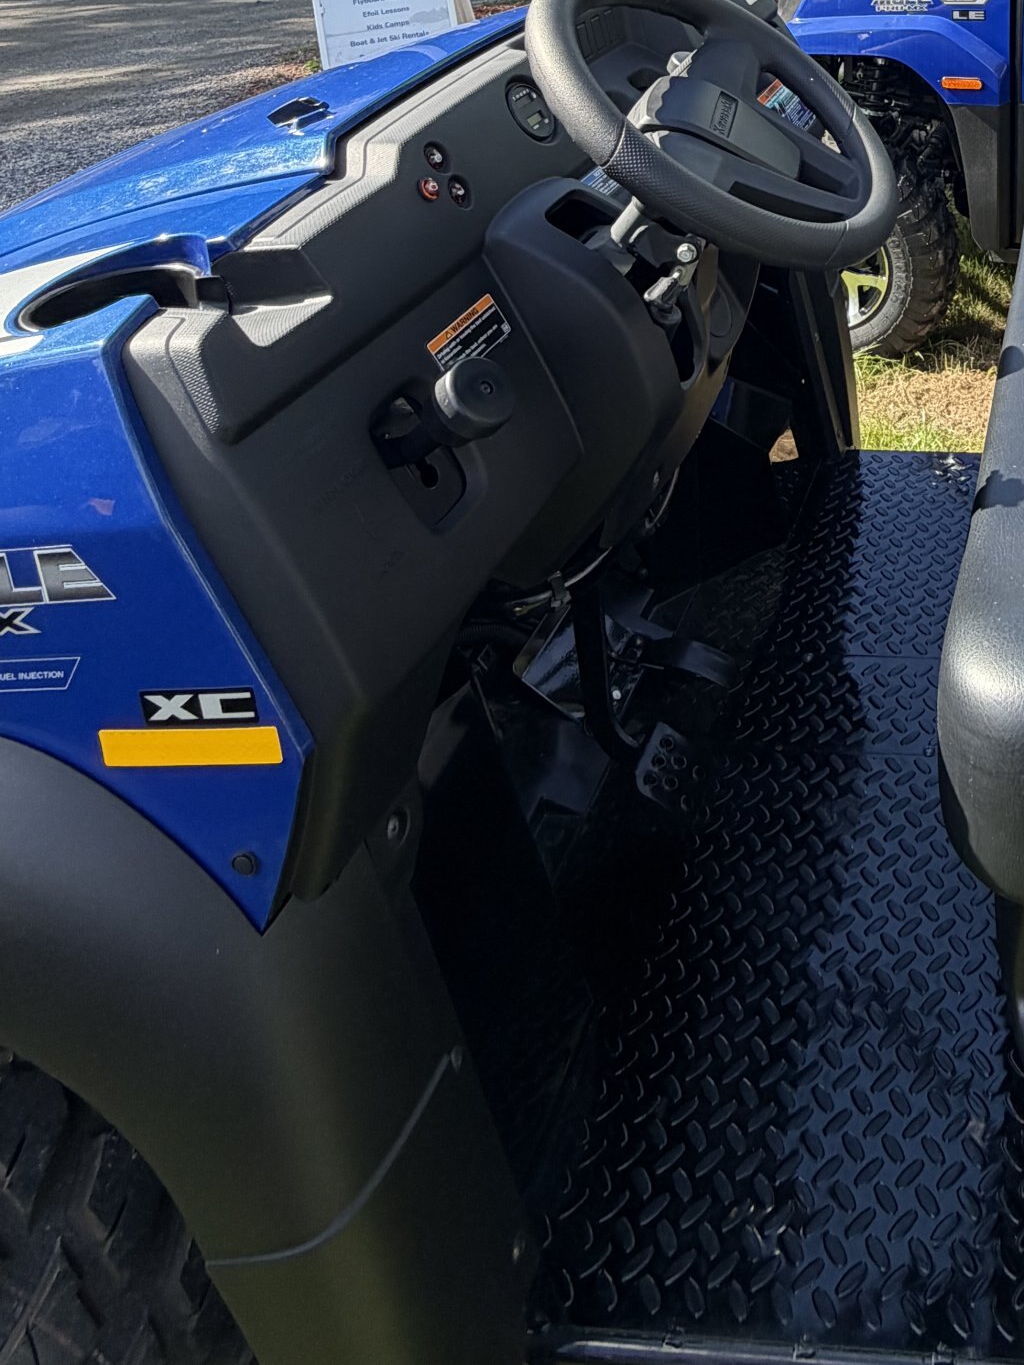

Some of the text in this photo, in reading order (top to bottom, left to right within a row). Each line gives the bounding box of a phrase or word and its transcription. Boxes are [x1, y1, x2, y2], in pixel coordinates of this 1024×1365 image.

[362, 5, 410, 18] Efoil Lessons
[952, 10, 986, 20] LE
[366, 19, 410, 31] Kids Camps
[350, 39, 368, 47] Boat
[369, 37, 376, 45] &
[389, 34, 400, 42] Ski
[450, 306, 480, 333] WARNING
[18, 670, 64, 680] INJECTION
[143, 692, 256, 721] XC
